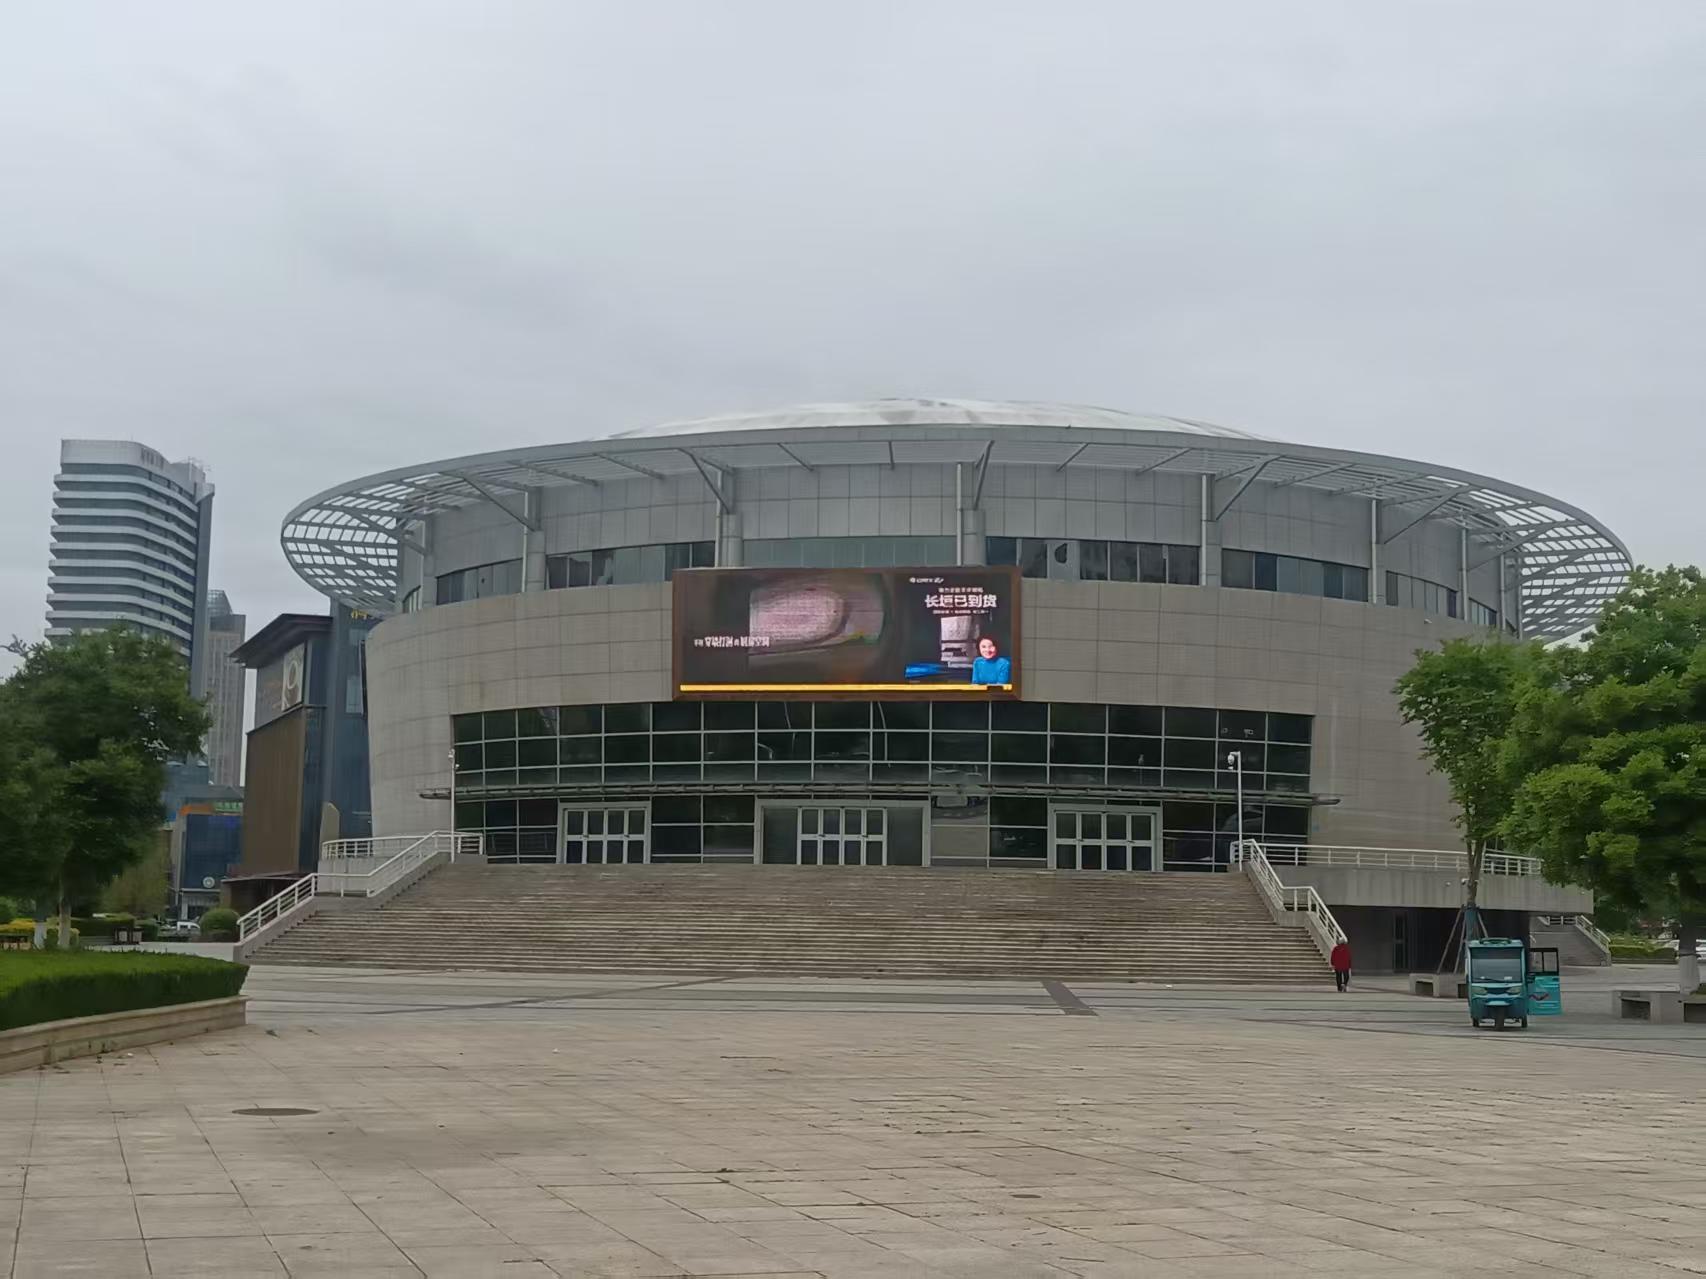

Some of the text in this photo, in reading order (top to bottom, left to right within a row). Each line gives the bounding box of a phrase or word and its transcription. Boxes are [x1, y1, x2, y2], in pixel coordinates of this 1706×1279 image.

[925, 594, 997, 608] 长垣已到货
